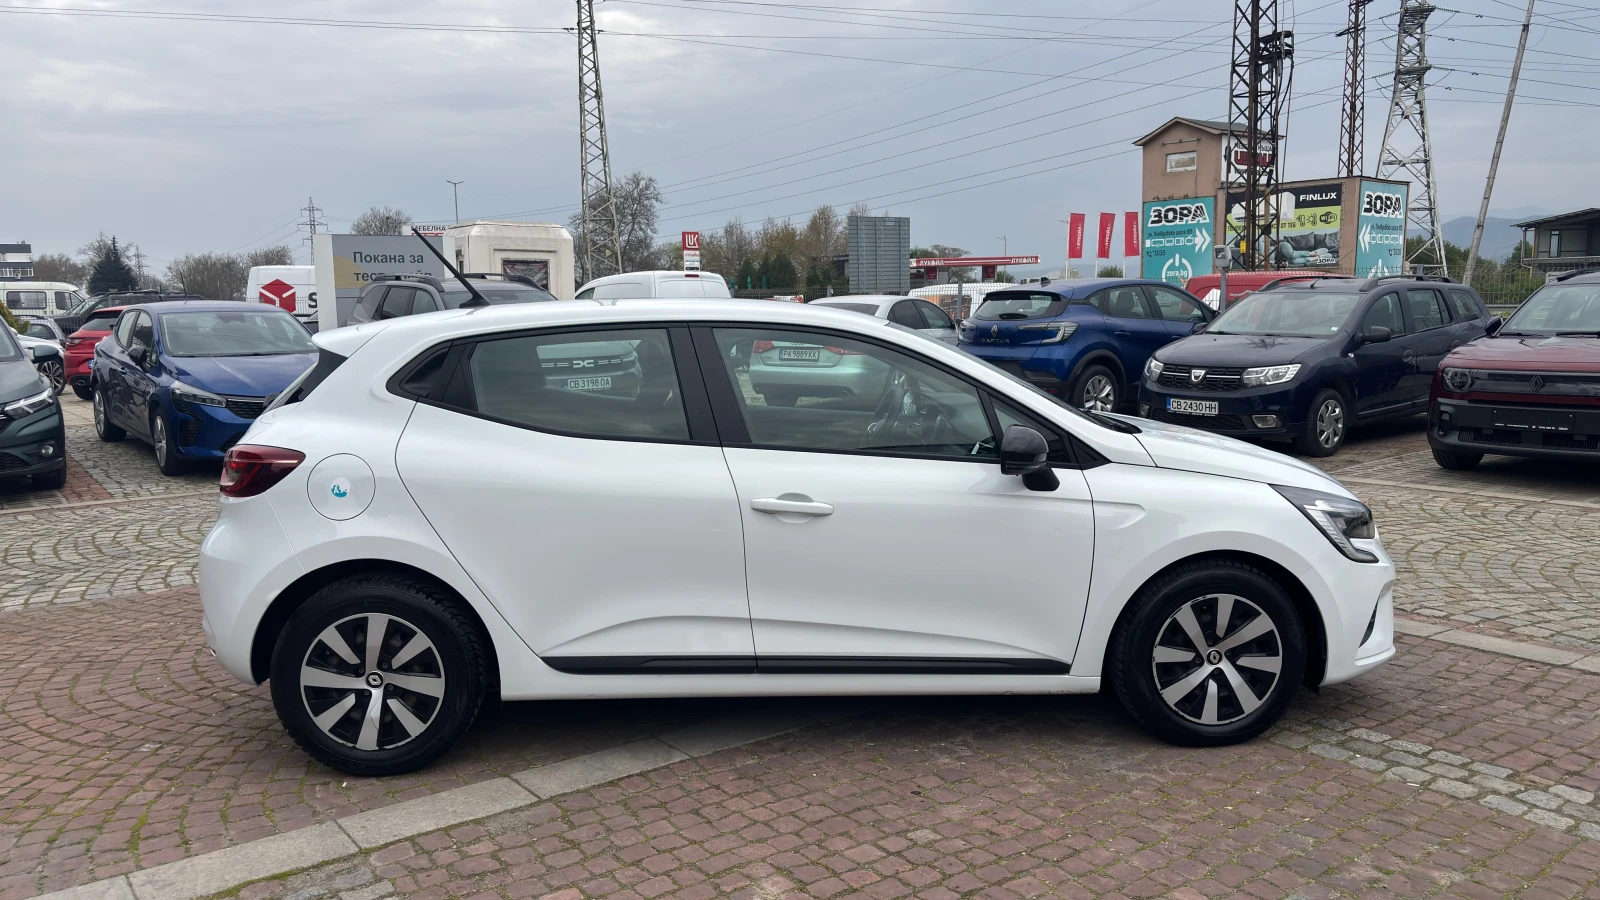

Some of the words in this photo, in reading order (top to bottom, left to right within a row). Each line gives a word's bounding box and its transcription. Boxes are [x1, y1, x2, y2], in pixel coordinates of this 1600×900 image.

[1299, 191, 1337, 202] FINLUX
[1361, 191, 1404, 218] ЗОРА
[1148, 203, 1210, 227] ЗОРА
[353, 251, 405, 264] Покана
[409, 254, 424, 264] за
[1166, 270, 1188, 278] zora.bg
[581, 379, 600, 388] 3198
[1172, 400, 1182, 410] CB
[1183, 402, 1204, 412] 2430
